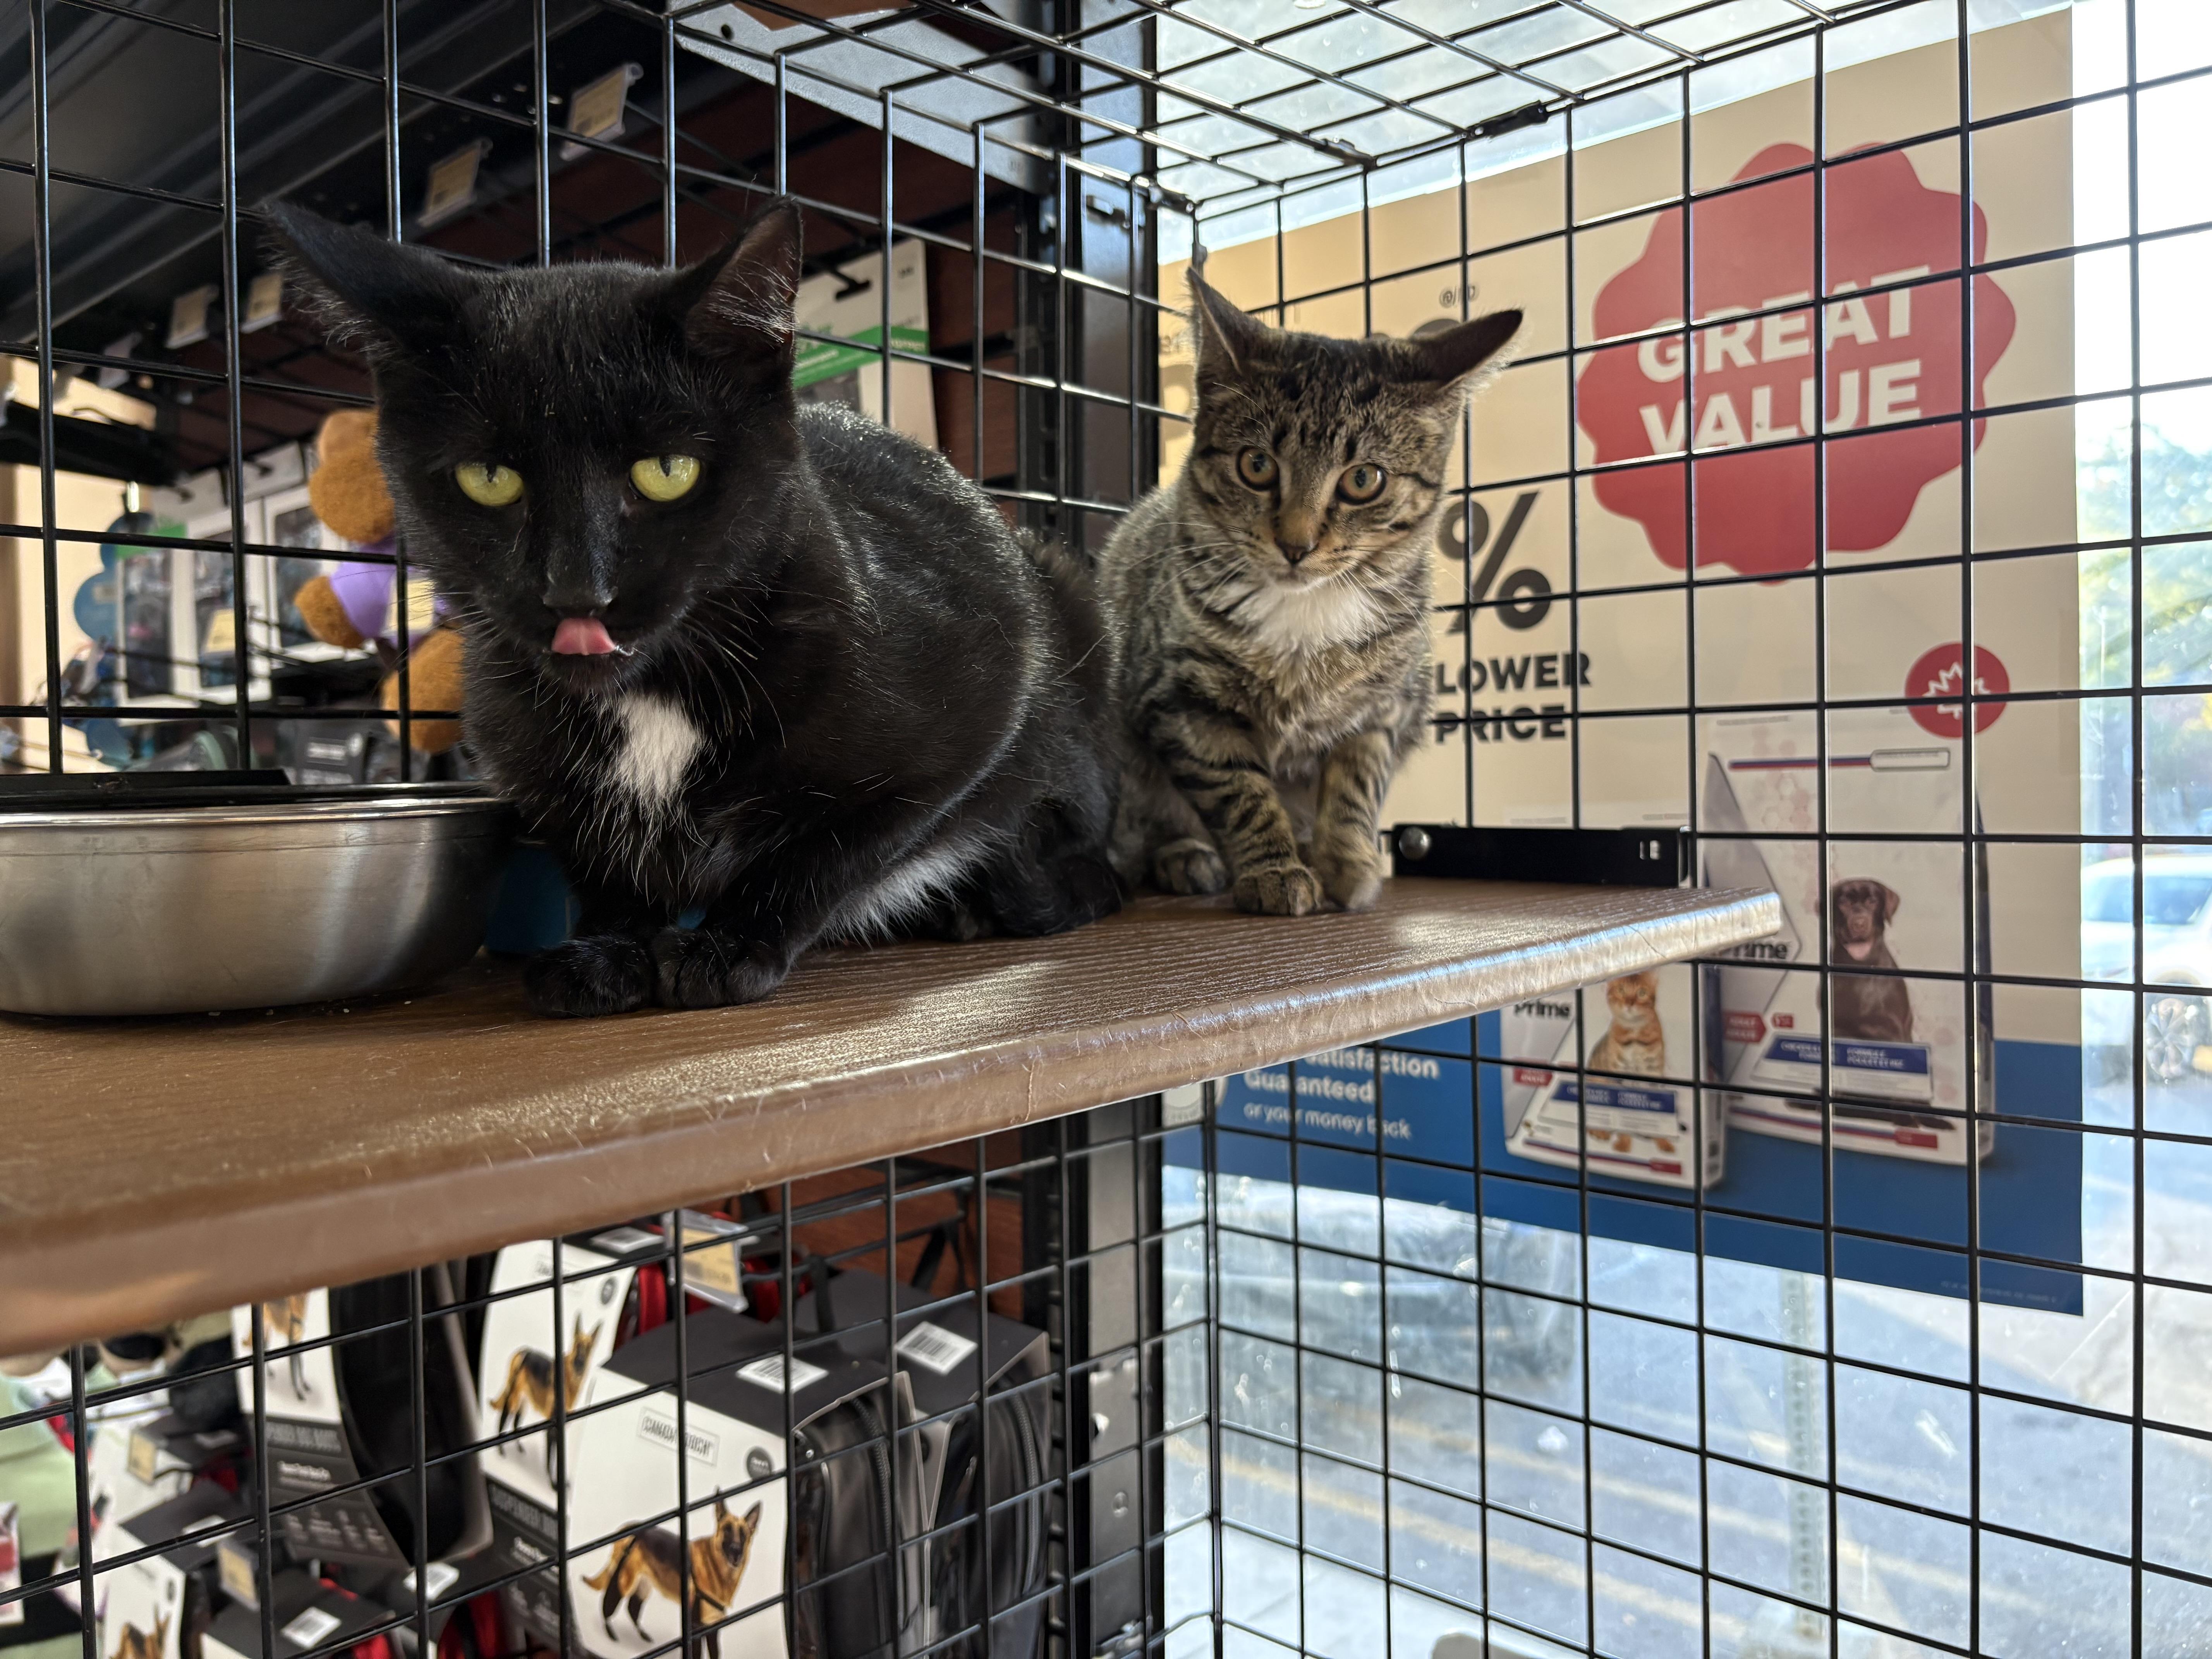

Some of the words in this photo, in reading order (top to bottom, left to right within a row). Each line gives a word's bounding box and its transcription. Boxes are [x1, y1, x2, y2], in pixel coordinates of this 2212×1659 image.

[1638, 265, 1930, 383] GREAT
[1639, 358, 1921, 459] VALUE
[1436, 653, 1591, 694] LOWER
[1436, 705, 1566, 744] PRICE
[1243, 1068, 1376, 1104] Guaanteed
[1243, 1103, 1262, 1120] or
[1305, 1110, 1365, 1138] money
